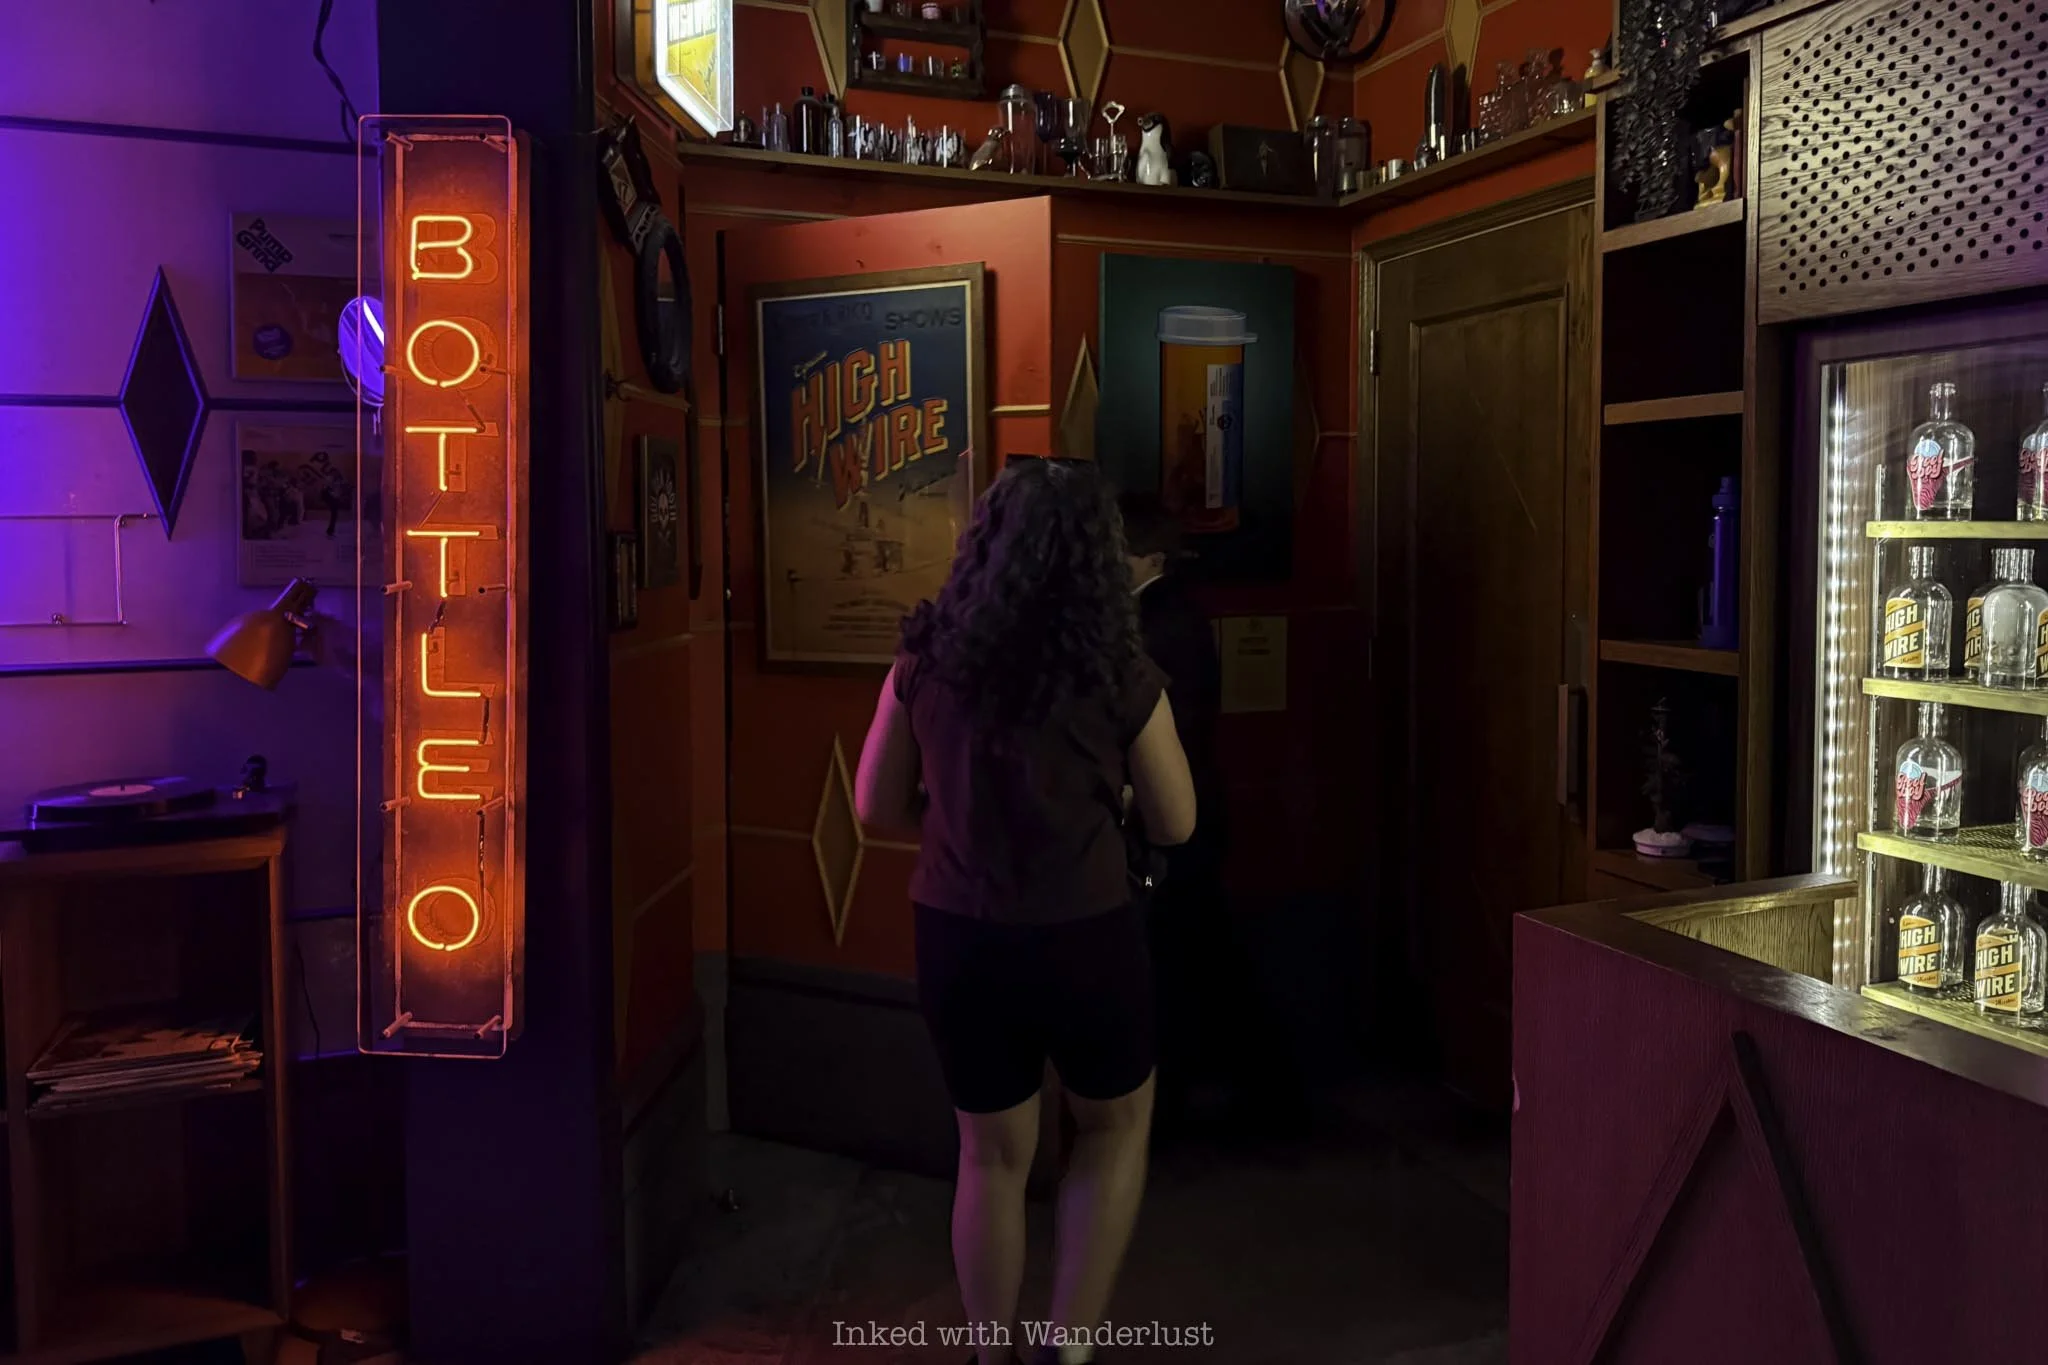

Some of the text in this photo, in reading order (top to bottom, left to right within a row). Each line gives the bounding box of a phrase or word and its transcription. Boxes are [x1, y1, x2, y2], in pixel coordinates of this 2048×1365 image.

[884, 308, 962, 330] SHOWS
[790, 338, 911, 474] HIGH
[829, 397, 948, 512] WIRE
[1885, 604, 1918, 634] HIGH
[1884, 632, 1919, 662] WIRE
[1901, 925, 1936, 949] HIGH
[1900, 953, 1937, 976] WIRE
[1976, 944, 2013, 970] HIGH
[1976, 973, 2015, 998] WIRE
